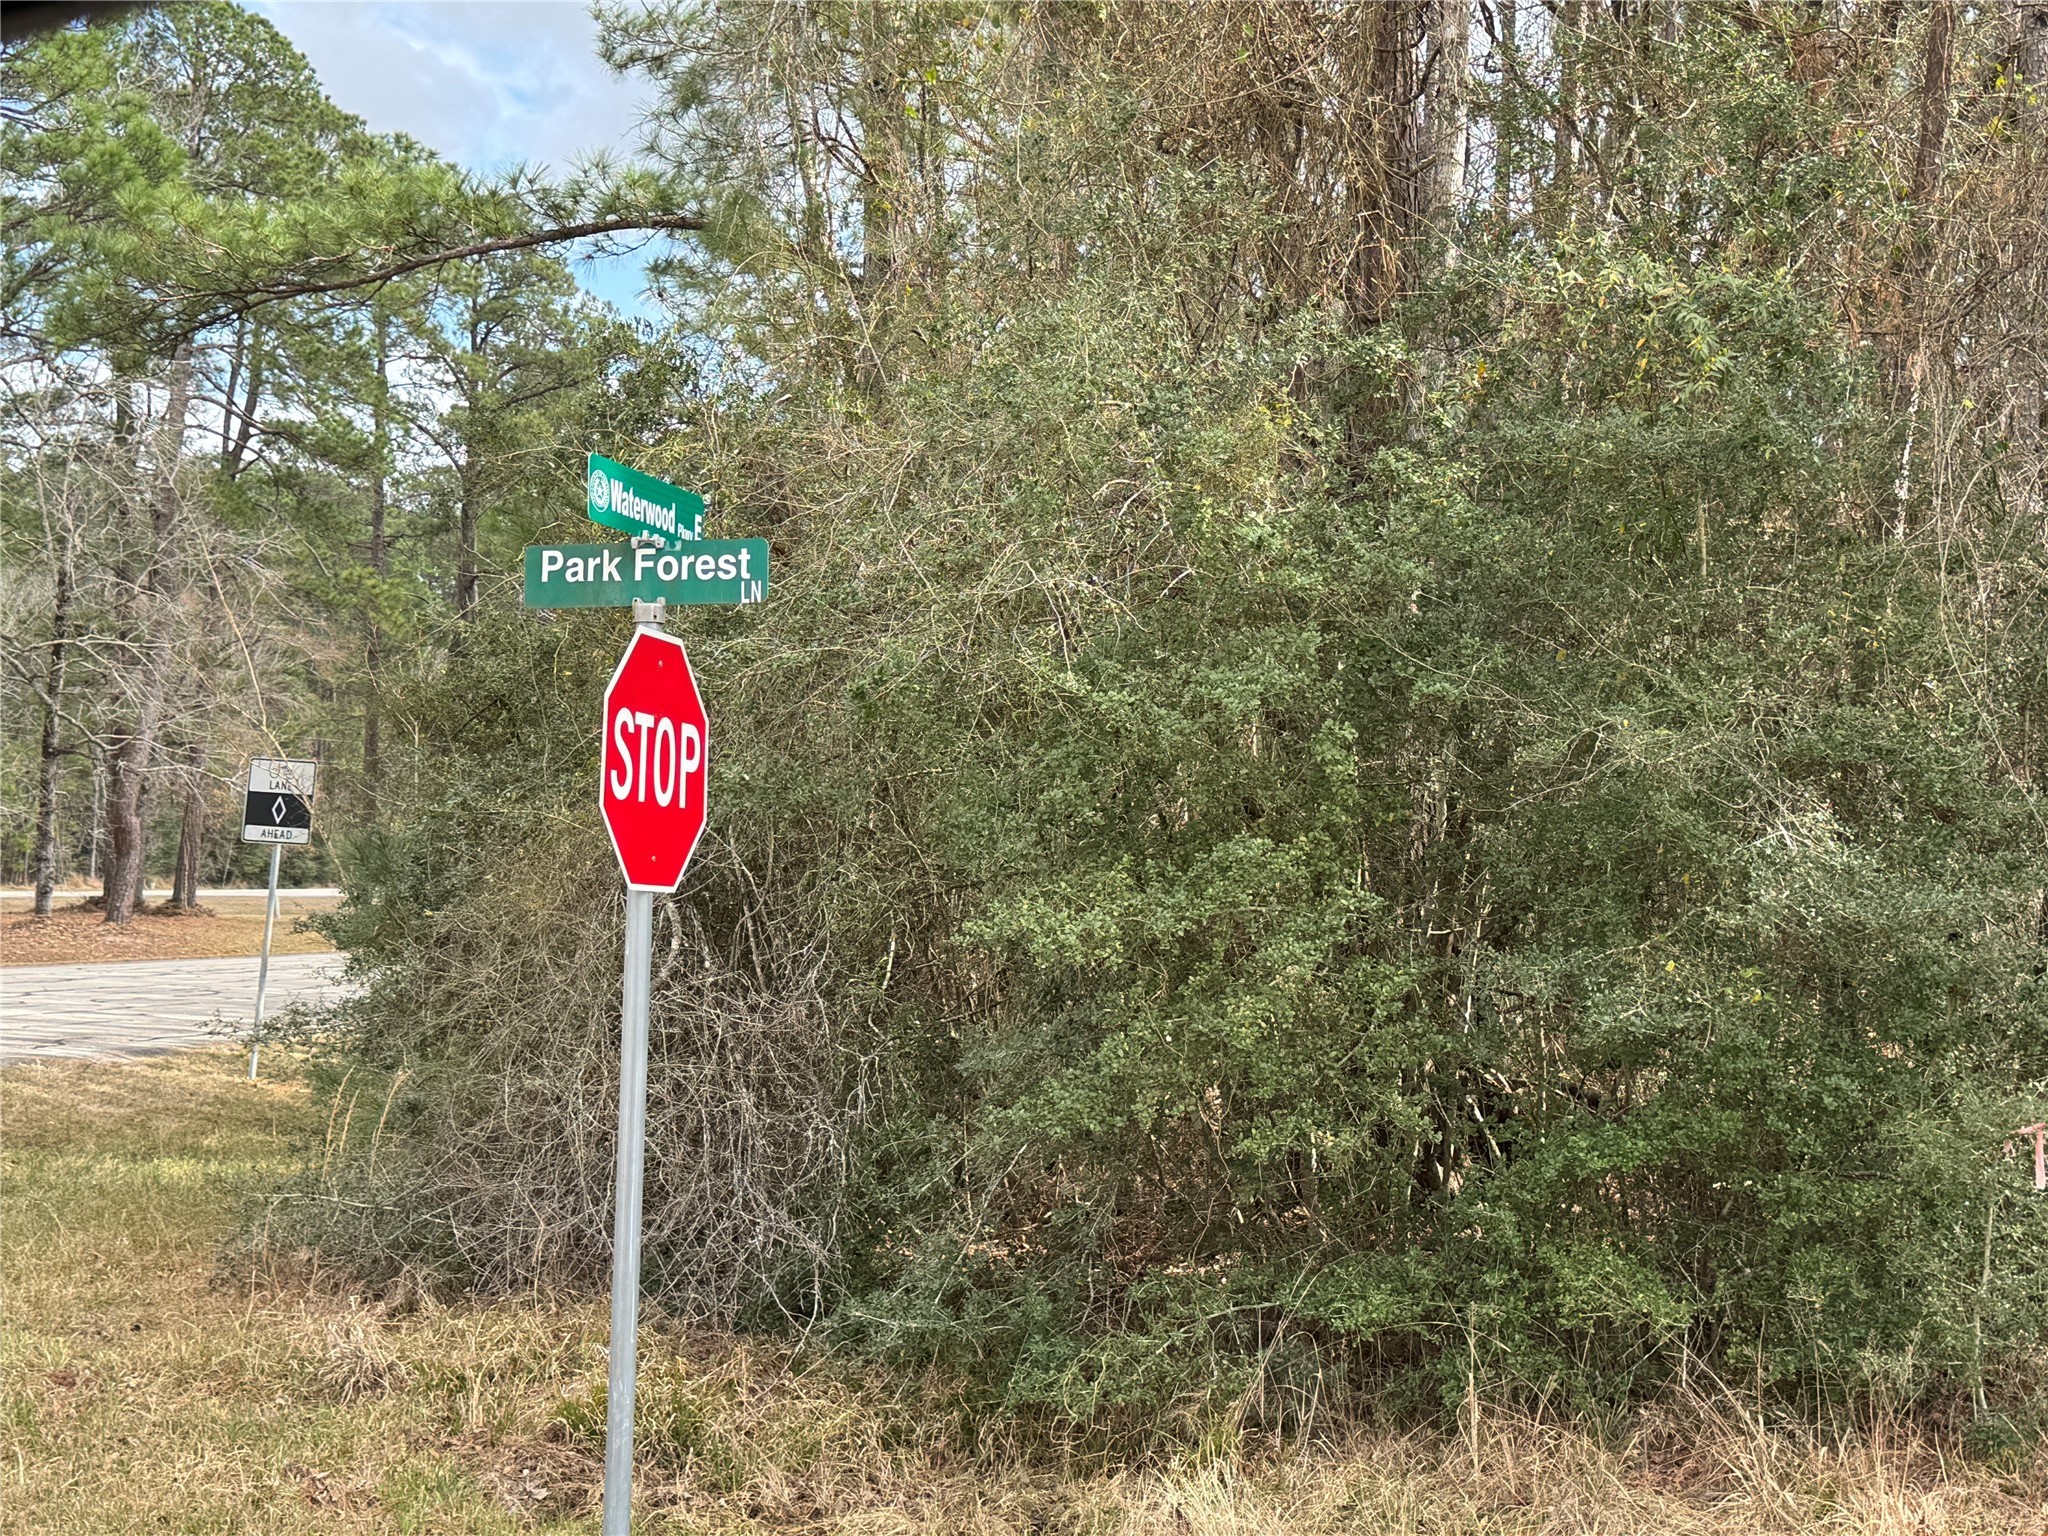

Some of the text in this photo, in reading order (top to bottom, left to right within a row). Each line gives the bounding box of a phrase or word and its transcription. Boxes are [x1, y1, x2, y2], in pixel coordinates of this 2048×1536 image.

[610, 478, 676, 534] Waterwood
[694, 513, 703, 541] E
[541, 547, 762, 604] Park Forest LN
[610, 707, 701, 809] STOP
[260, 829, 293, 840] AHEAD
